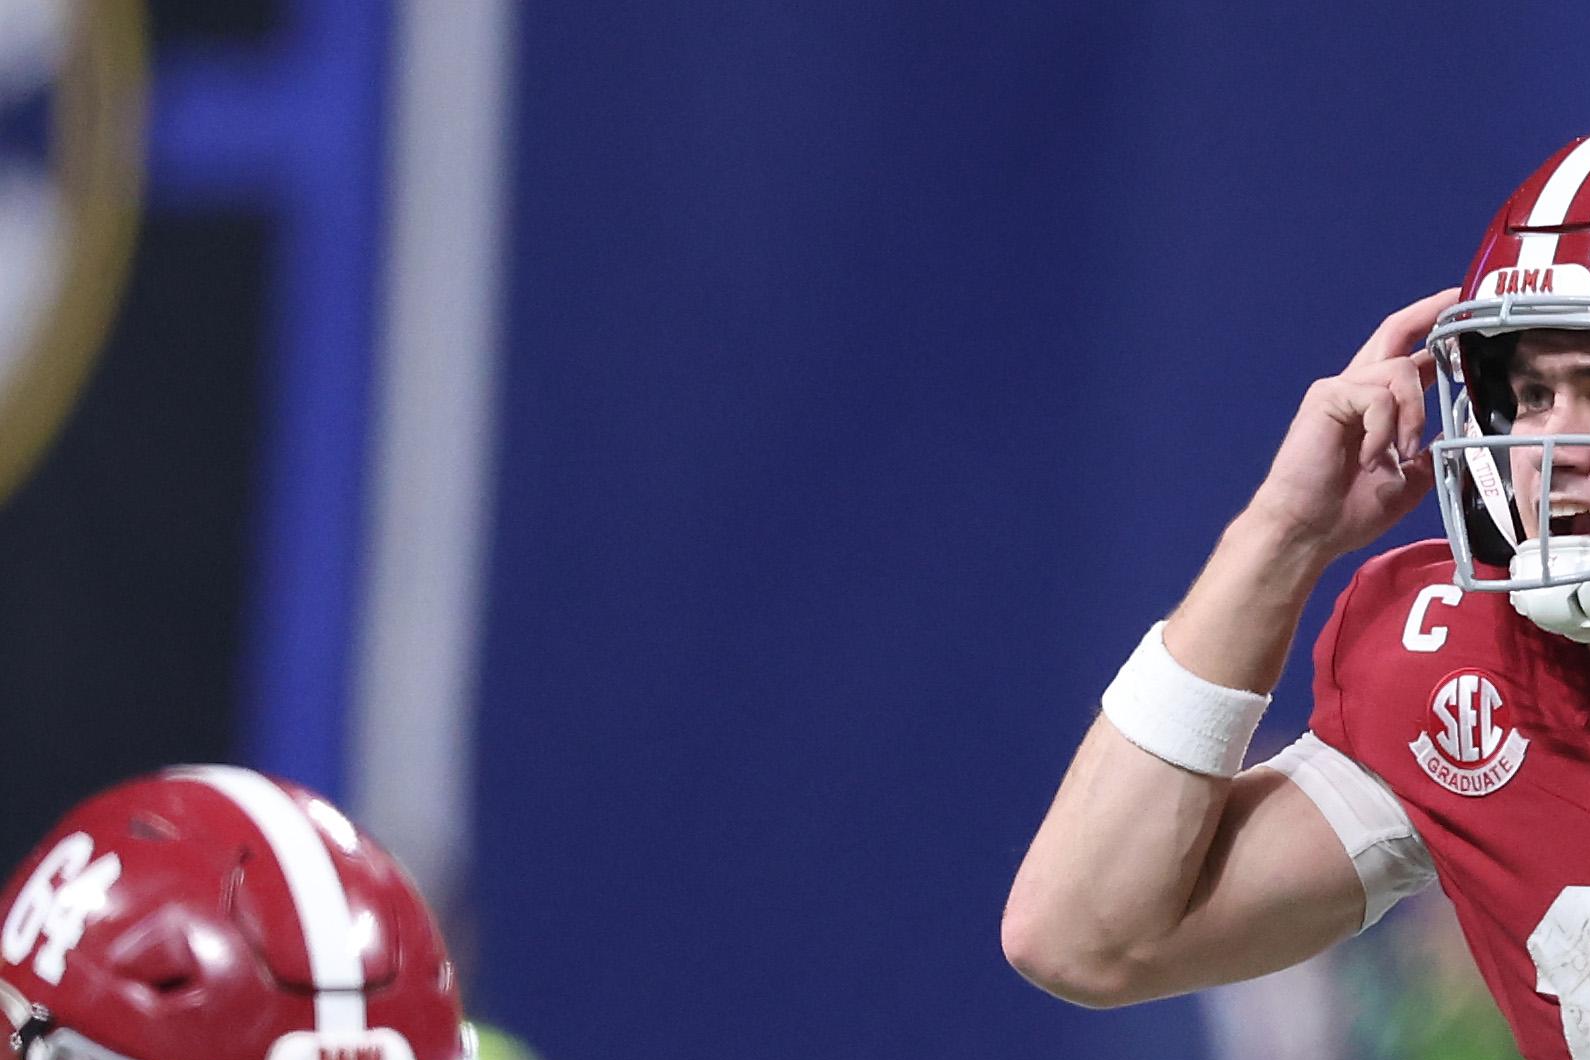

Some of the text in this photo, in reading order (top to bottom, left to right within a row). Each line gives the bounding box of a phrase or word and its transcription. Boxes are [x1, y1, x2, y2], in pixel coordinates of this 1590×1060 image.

[1494, 268, 1554, 296] BAMA
[1402, 584, 1463, 652] C
[1432, 674, 1503, 762] SEC
[1427, 756, 1513, 793] GRADUATE
[1, 830, 122, 986] 64
